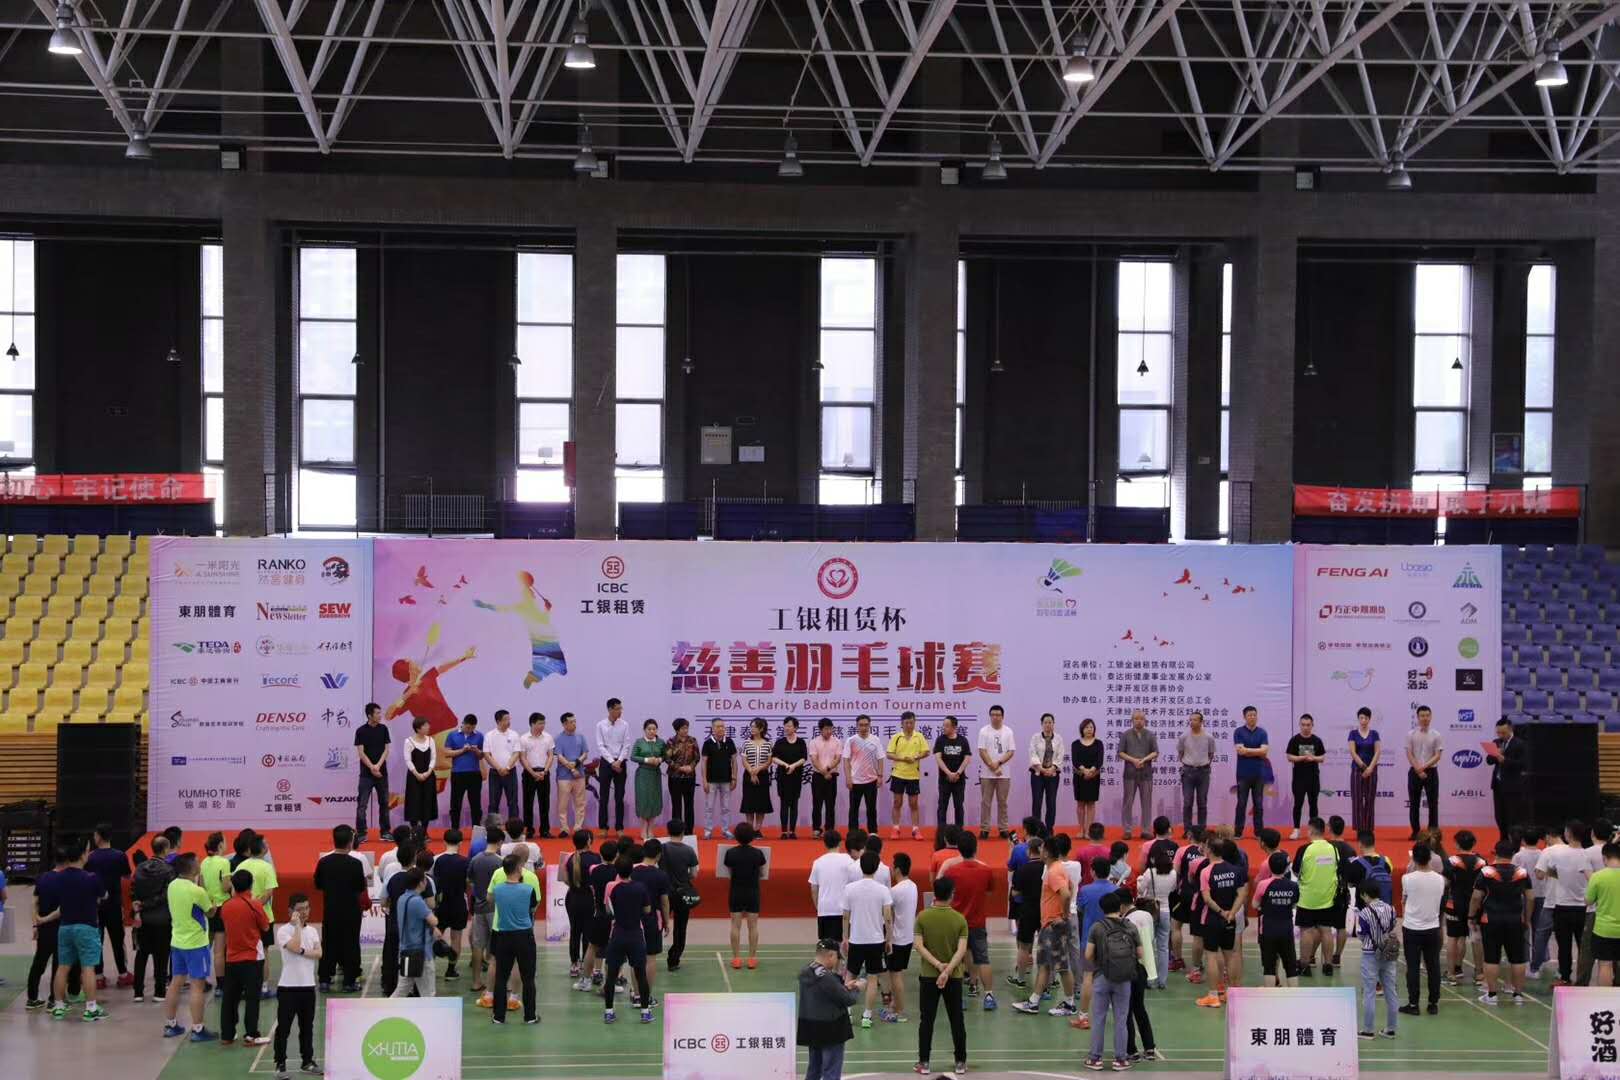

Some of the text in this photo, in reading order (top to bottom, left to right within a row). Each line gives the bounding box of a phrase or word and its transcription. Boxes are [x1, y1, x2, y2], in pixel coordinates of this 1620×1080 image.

[71, 477, 184, 501] 牢记使命
[257, 559, 306, 570] RANKO
[597, 582, 629, 593] ICBC
[178, 605, 237, 618] 東朋體育
[319, 602, 352, 613] SEW
[580, 599, 646, 615] 工银租赁
[768, 606, 907, 632] 工银租赁杯
[671, 640, 1002, 694] 慈善羽毛球赛
[1107, 660, 1195, 669] 工银金融租赁有限公司
[1063, 672, 1102, 681] 主办单位：
[1106, 684, 1185, 693] 天津开发区慈善协会
[706, 698, 968, 713] TEDA Charity Badminton Tournament
[1106, 696, 1212, 705] 天津经济技术开发区总工会
[256, 712, 307, 723] DENSO
[178, 789, 241, 798] KUMHO TIRE
[264, 803, 302, 812] 工银租赁
[1269, 890, 1294, 898] RANKO
[1250, 1027, 1338, 1046] 東朋體育
[673, 1036, 787, 1049] ICBC 工银租赁
